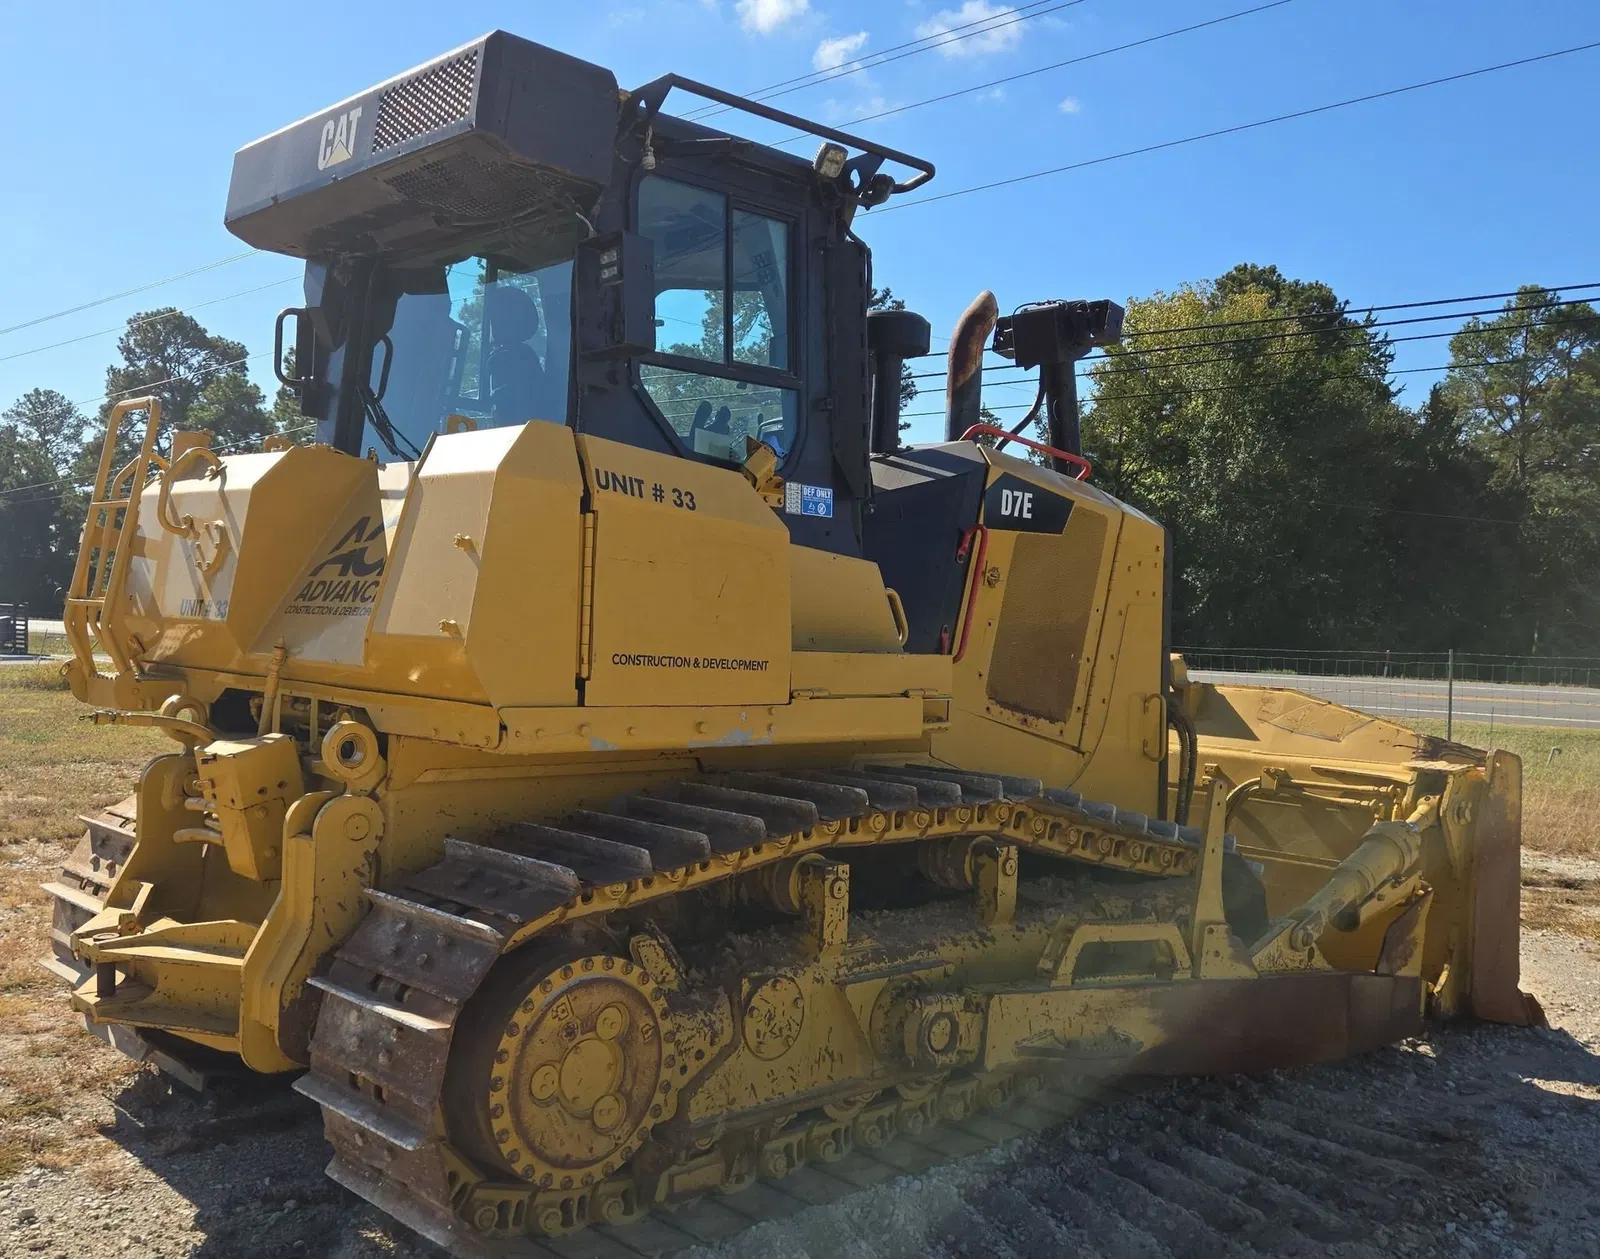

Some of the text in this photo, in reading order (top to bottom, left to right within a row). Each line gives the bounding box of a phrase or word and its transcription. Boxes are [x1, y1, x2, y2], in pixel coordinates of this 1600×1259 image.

[317, 106, 363, 171] CAT
[594, 467, 697, 511] UNIT # 33
[803, 487, 831, 499] DEF ONLY
[1001, 488, 1033, 520] D7E
[293, 580, 380, 603] ADVANC
[284, 605, 333, 616] CONSTRUCTION
[611, 653, 769, 671] CONSTRUCTION & DEVELOPMENT
